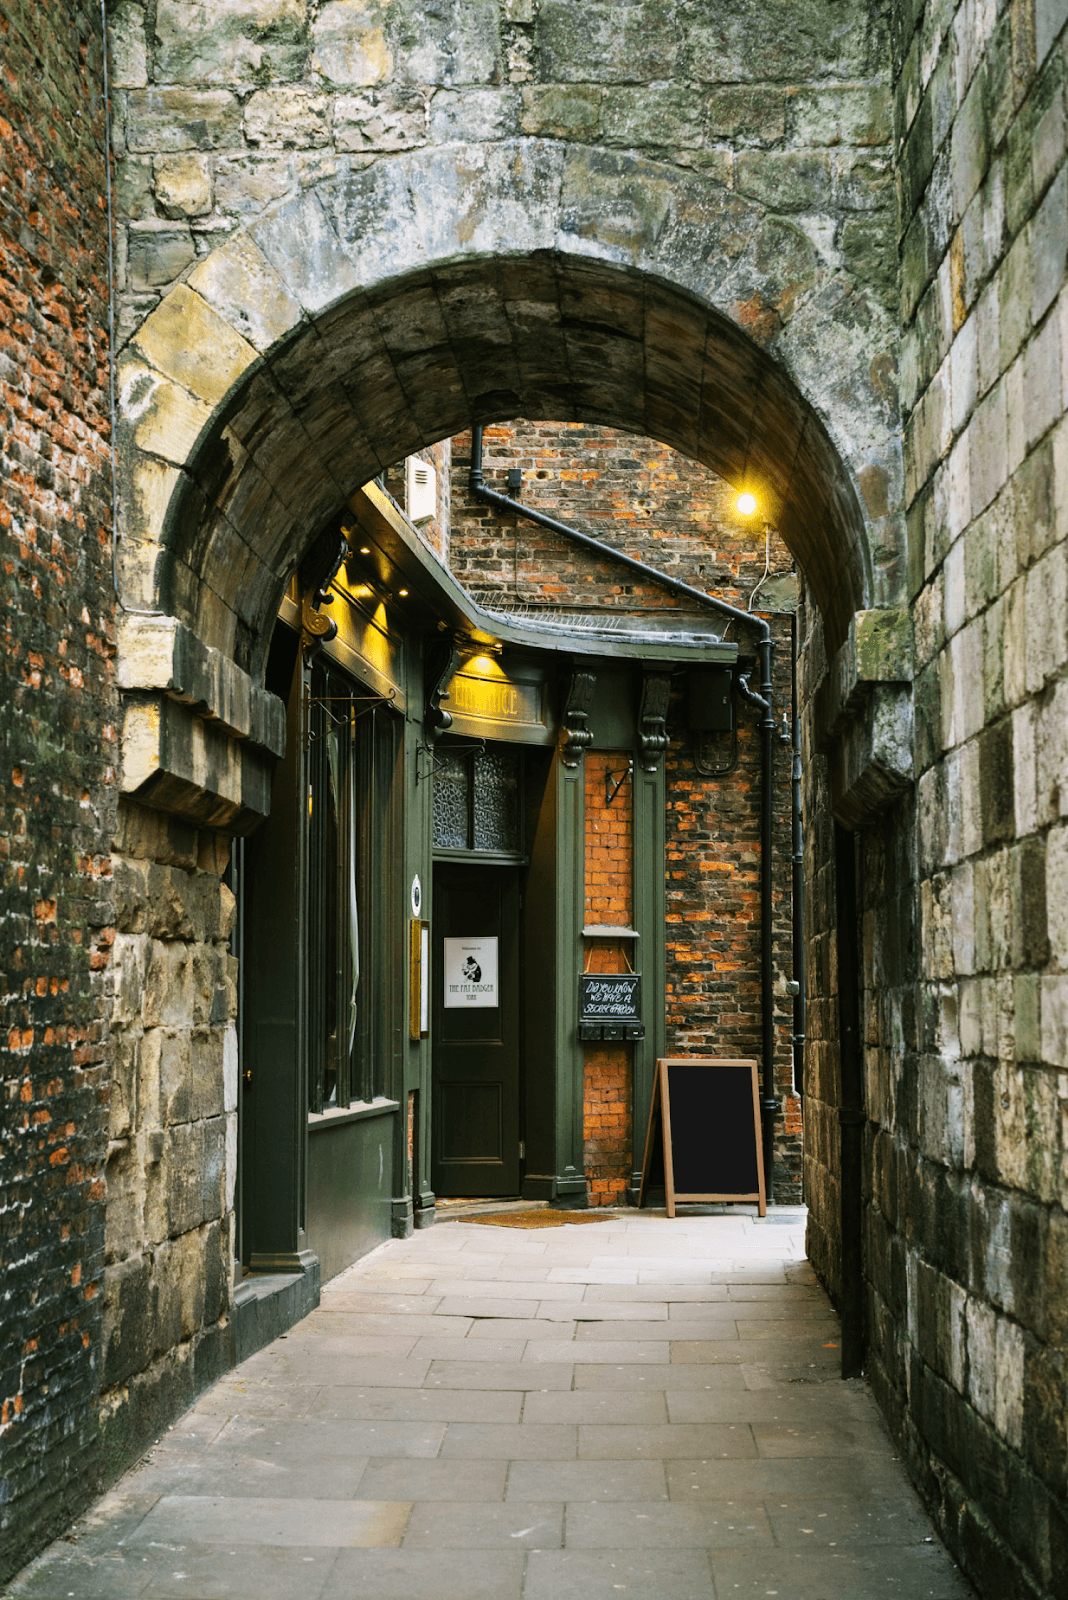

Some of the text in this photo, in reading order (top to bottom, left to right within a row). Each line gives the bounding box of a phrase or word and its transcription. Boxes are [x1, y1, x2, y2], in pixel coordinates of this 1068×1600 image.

[449, 984, 494, 993] THE FAT BADGER
[599, 982, 614, 994] YOU
[613, 981, 636, 993] KNOW
[590, 992, 632, 1003] WE HAVE A
[584, 1003, 636, 1015] SECRET GARDEN
